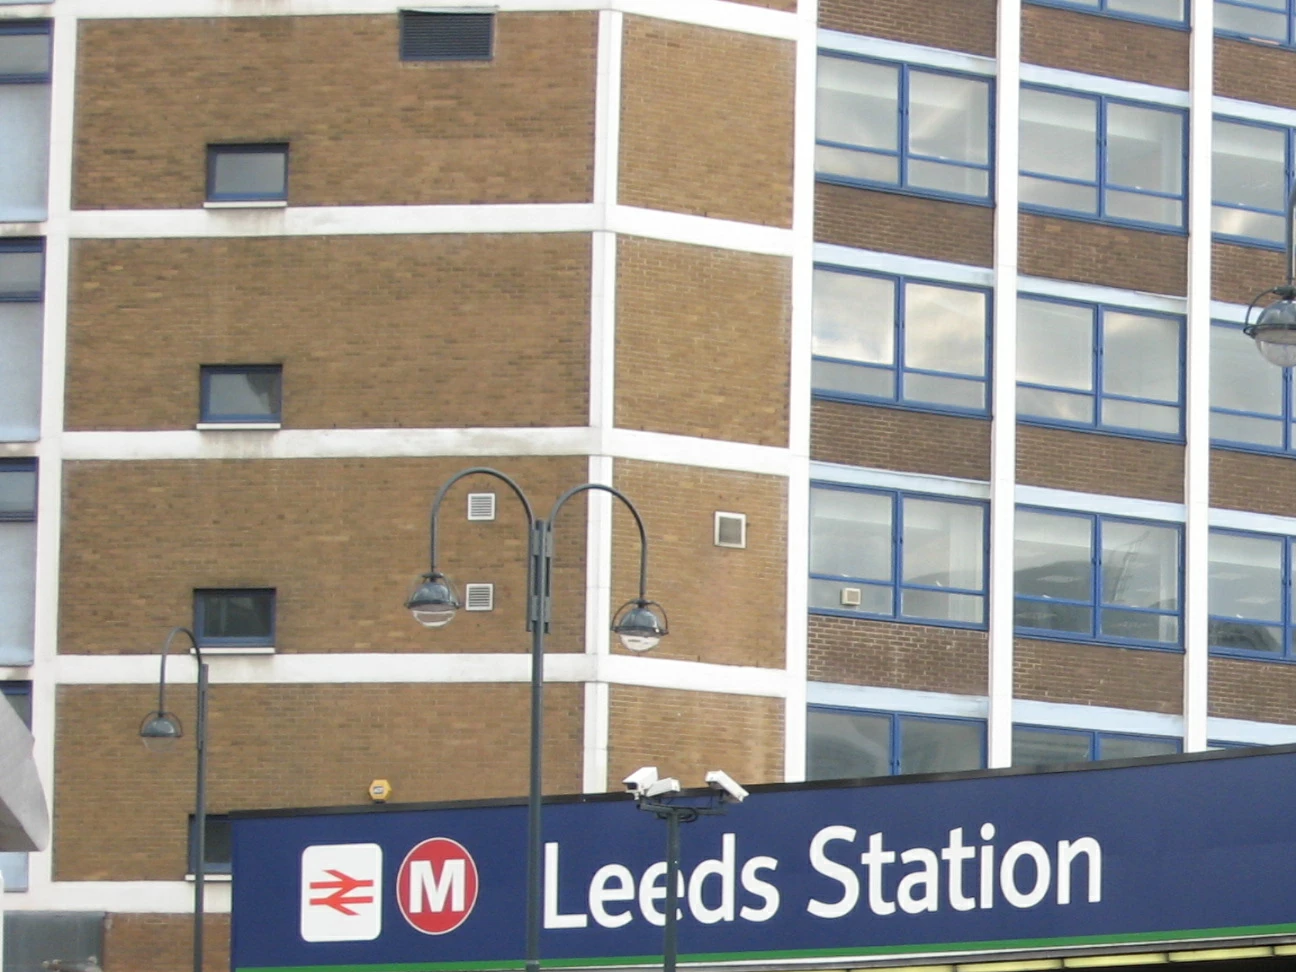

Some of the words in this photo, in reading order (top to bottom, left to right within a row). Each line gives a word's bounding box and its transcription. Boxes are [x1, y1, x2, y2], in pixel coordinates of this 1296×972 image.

[410, 859, 466, 914] M
[544, 833, 778, 929] Leeds
[806, 823, 1101, 919] Station
